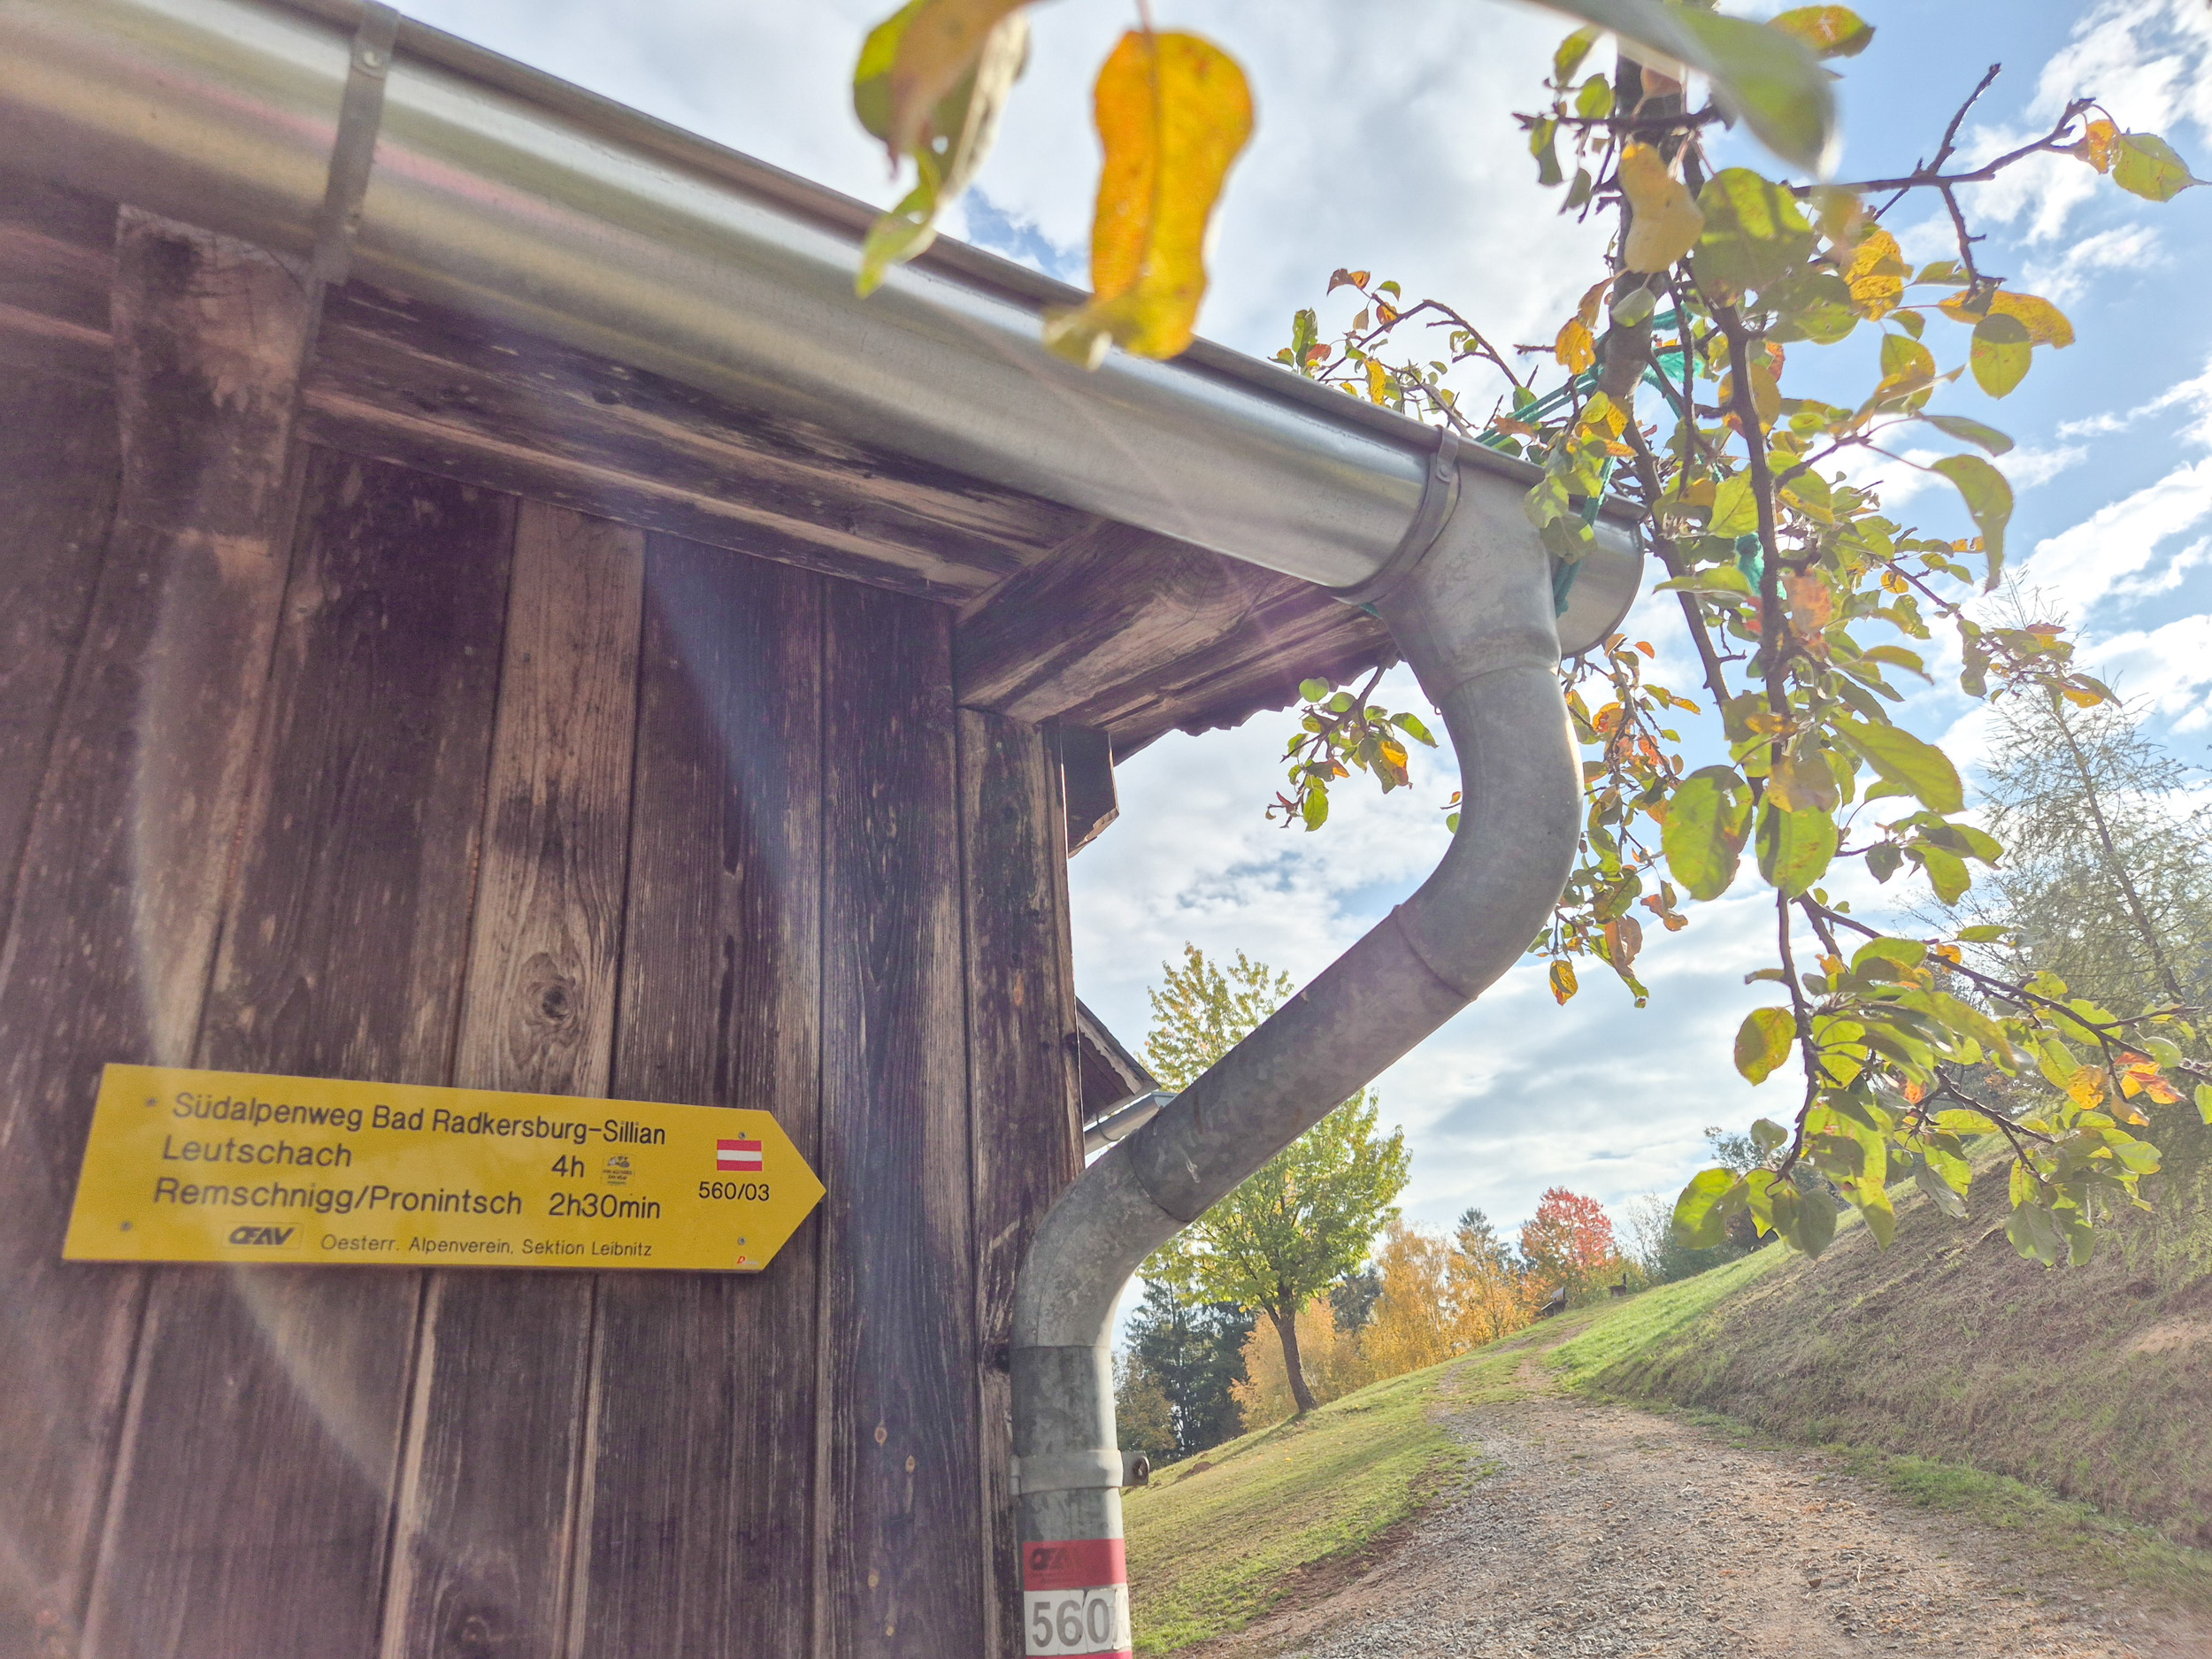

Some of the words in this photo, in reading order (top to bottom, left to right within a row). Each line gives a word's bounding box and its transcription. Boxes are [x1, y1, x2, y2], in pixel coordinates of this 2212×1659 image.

[173, 1091, 363, 1132] Südalpenweg
[372, 1104, 425, 1132] Bad
[162, 1135, 353, 1168] Leutschach
[551, 1154, 585, 1178] 4h
[153, 1178, 522, 1215] Remschnigg/Pronintsch
[549, 1192, 661, 1219] 2h30min
[698, 1182, 770, 1202] 560/03
[320, 1233, 401, 1253] Oesterr.
[522, 1239, 585, 1256] Sektion
[591, 1240, 652, 1257] Leibnitz
